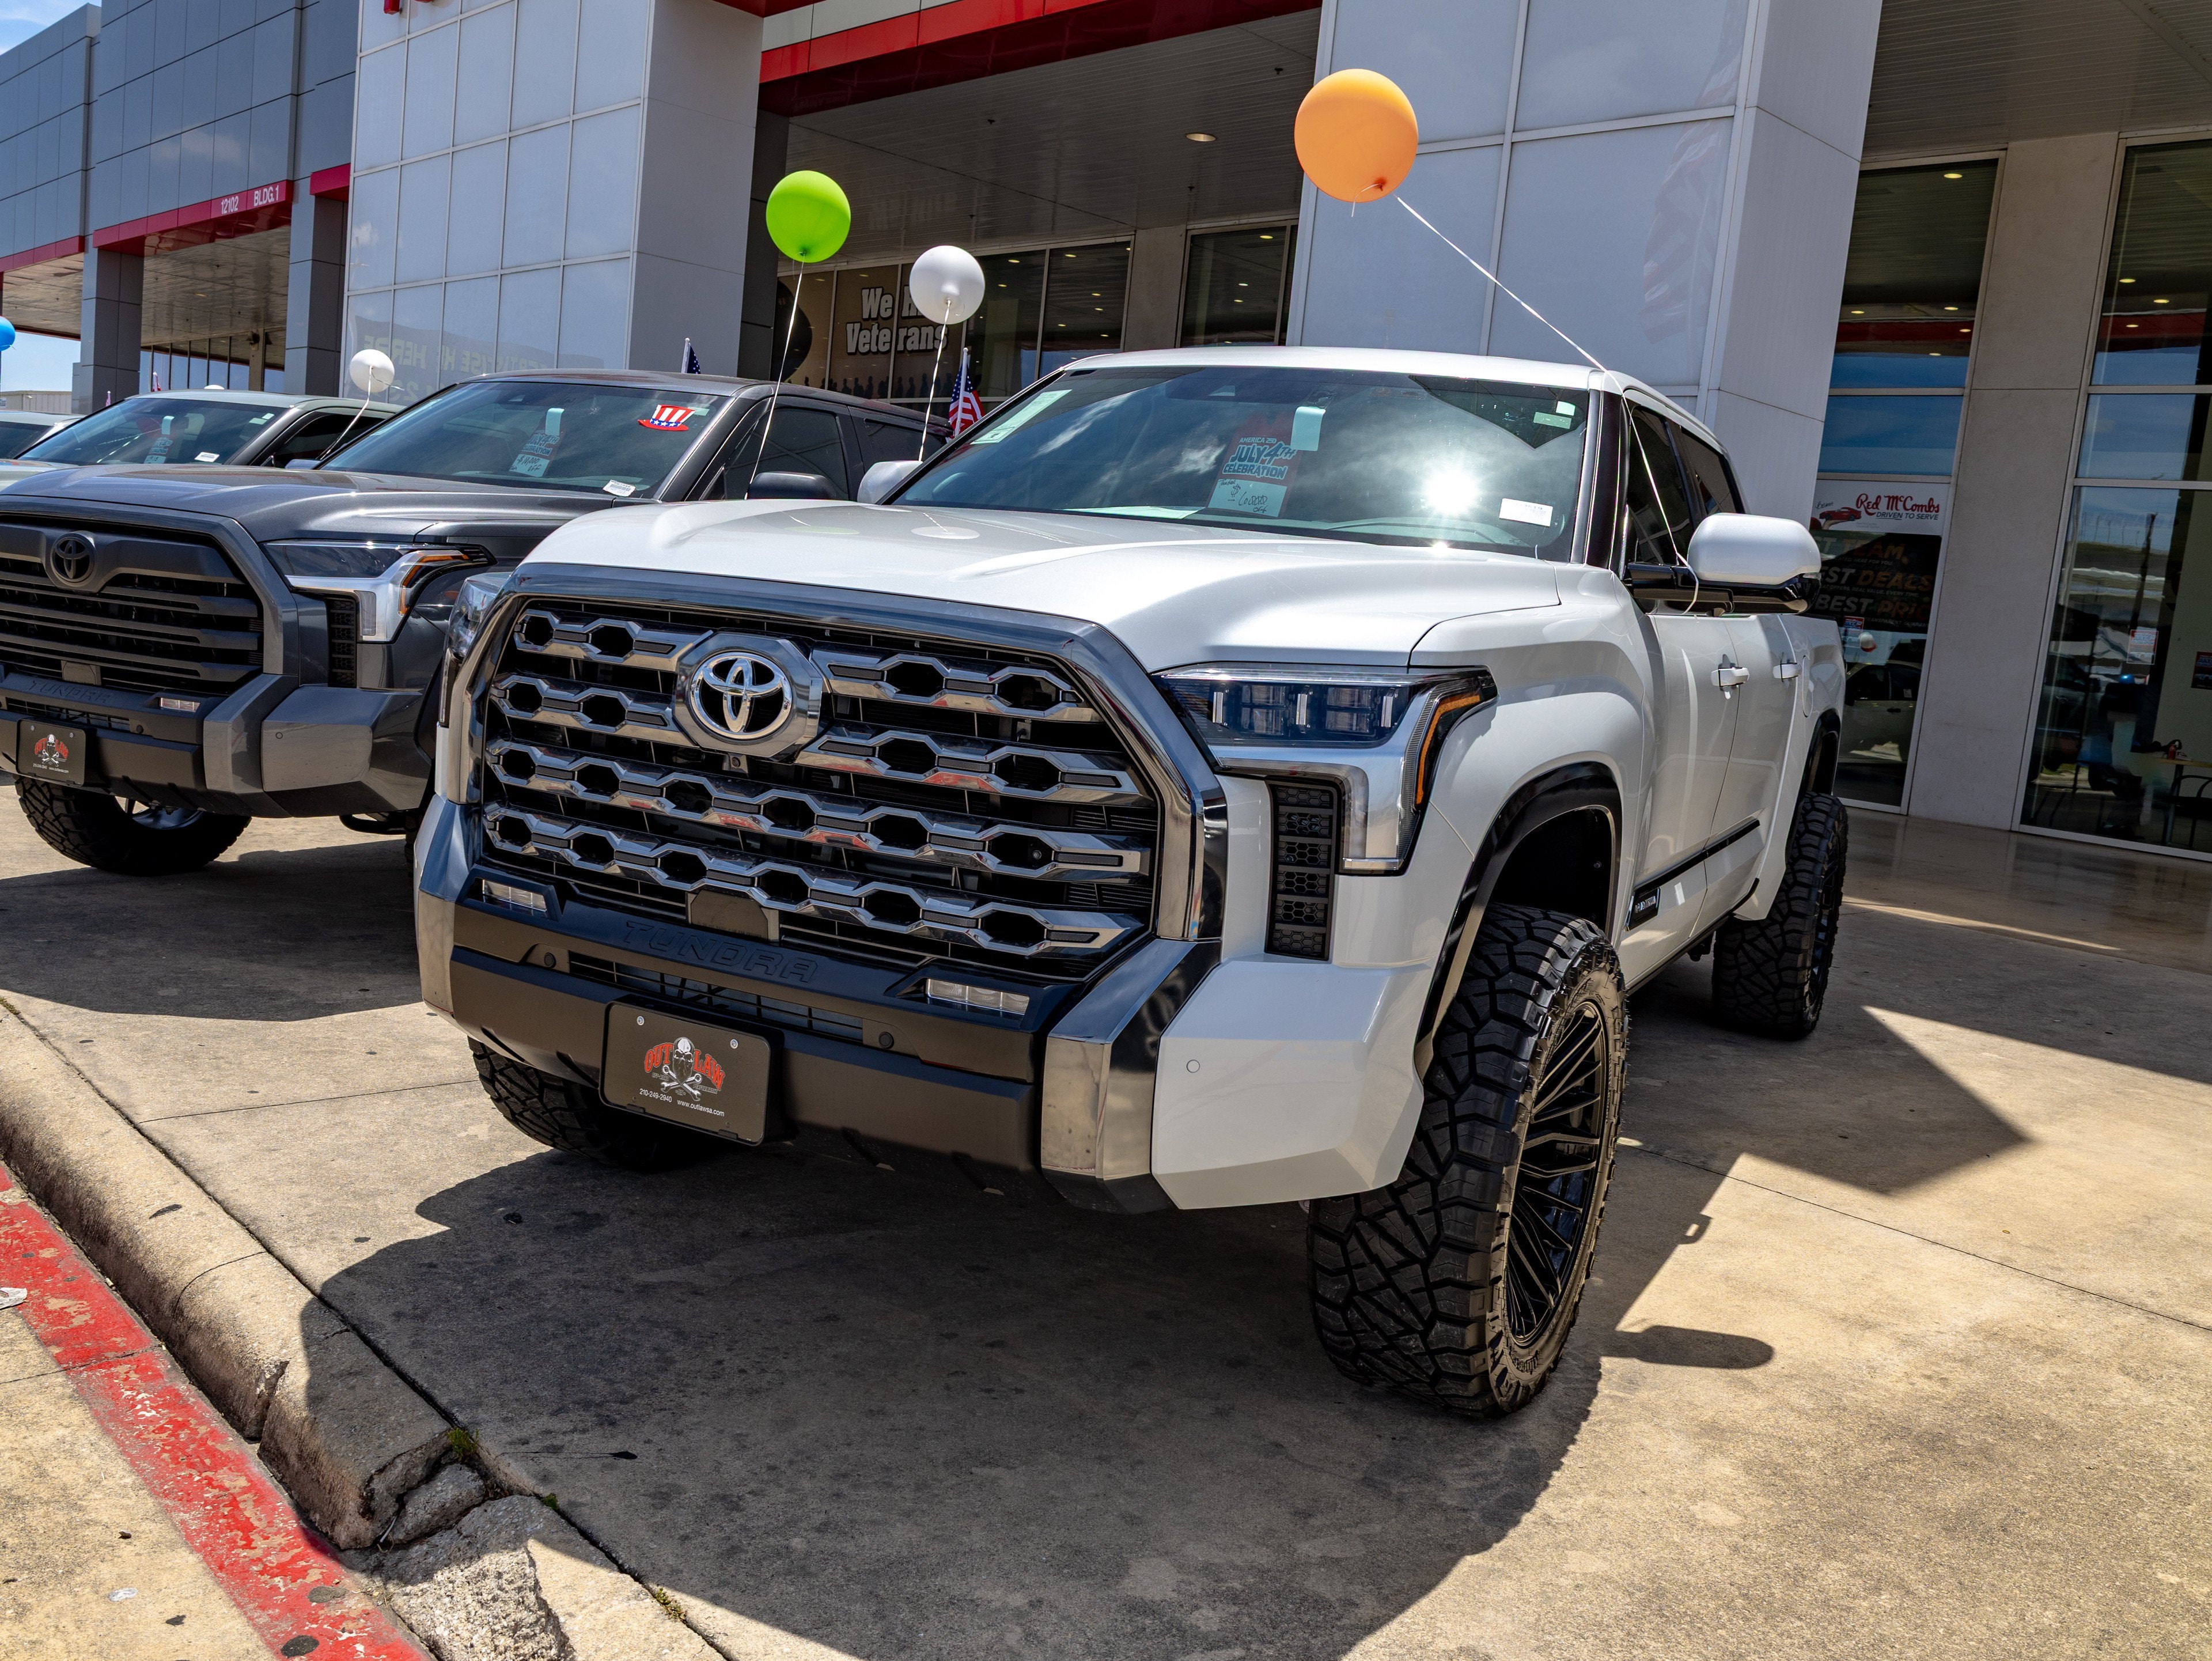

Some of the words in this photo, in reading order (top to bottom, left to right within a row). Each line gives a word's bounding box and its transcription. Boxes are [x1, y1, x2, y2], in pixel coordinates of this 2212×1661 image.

[221, 195, 239, 214] 12102
[862, 287, 892, 319] We
[846, 321, 948, 354] Veterans
[1228, 444, 1267, 464] JULY
[1222, 461, 1289, 479] CELEBRATION
[1855, 493, 1881, 516] Red
[1884, 494, 1940, 513] McCombs
[1876, 511, 1902, 519] DRIVEN
[1815, 593, 1874, 615] BEST
[623, 920, 819, 983] TUNDRA
[639, 1088, 672, 1103] 210-249-2940
[677, 1099, 725, 1117] www.outlawsa.com
